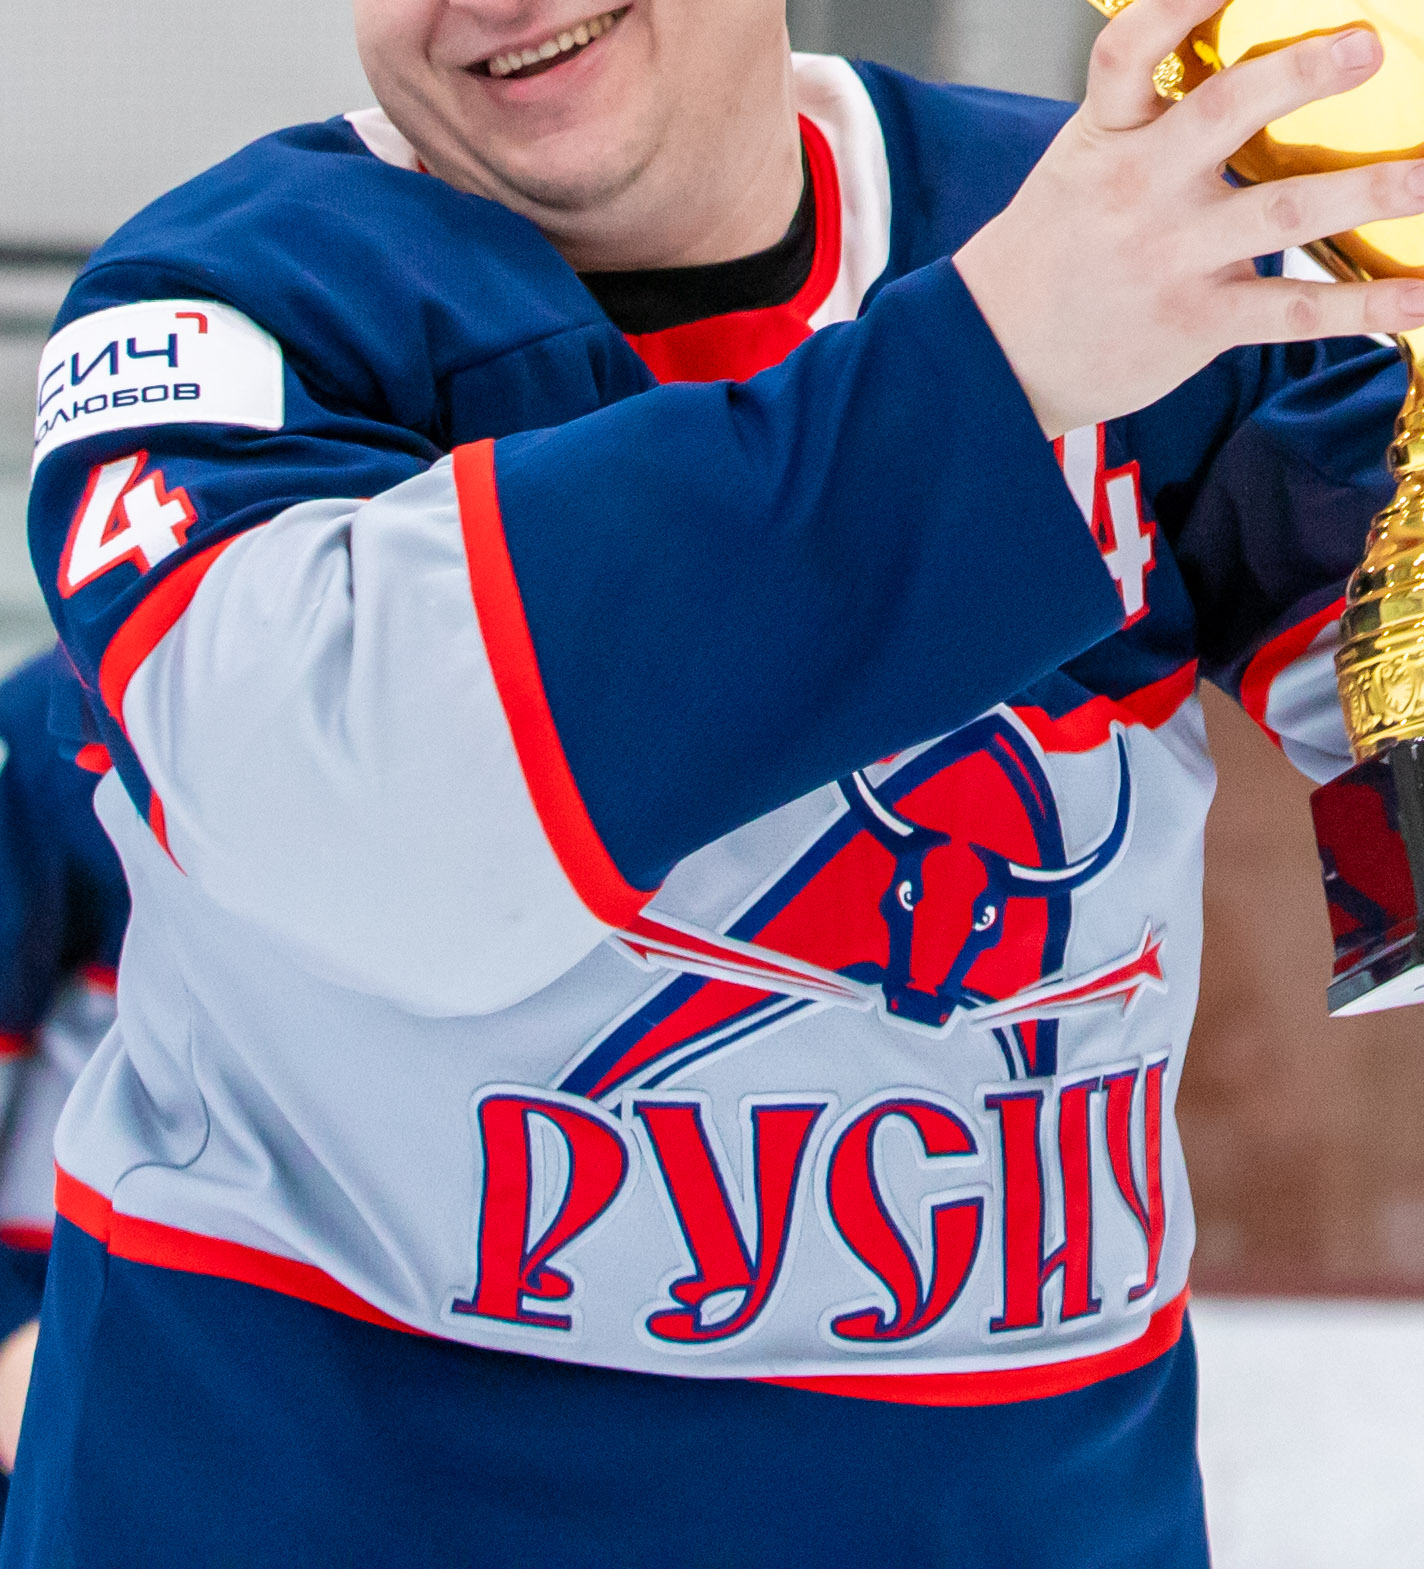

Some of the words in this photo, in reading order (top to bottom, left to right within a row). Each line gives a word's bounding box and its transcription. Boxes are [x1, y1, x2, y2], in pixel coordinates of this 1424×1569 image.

[57, 448, 198, 600] 4
[1052, 420, 1157, 631] 4
[450, 1054, 1172, 1346] РУСИЧ
